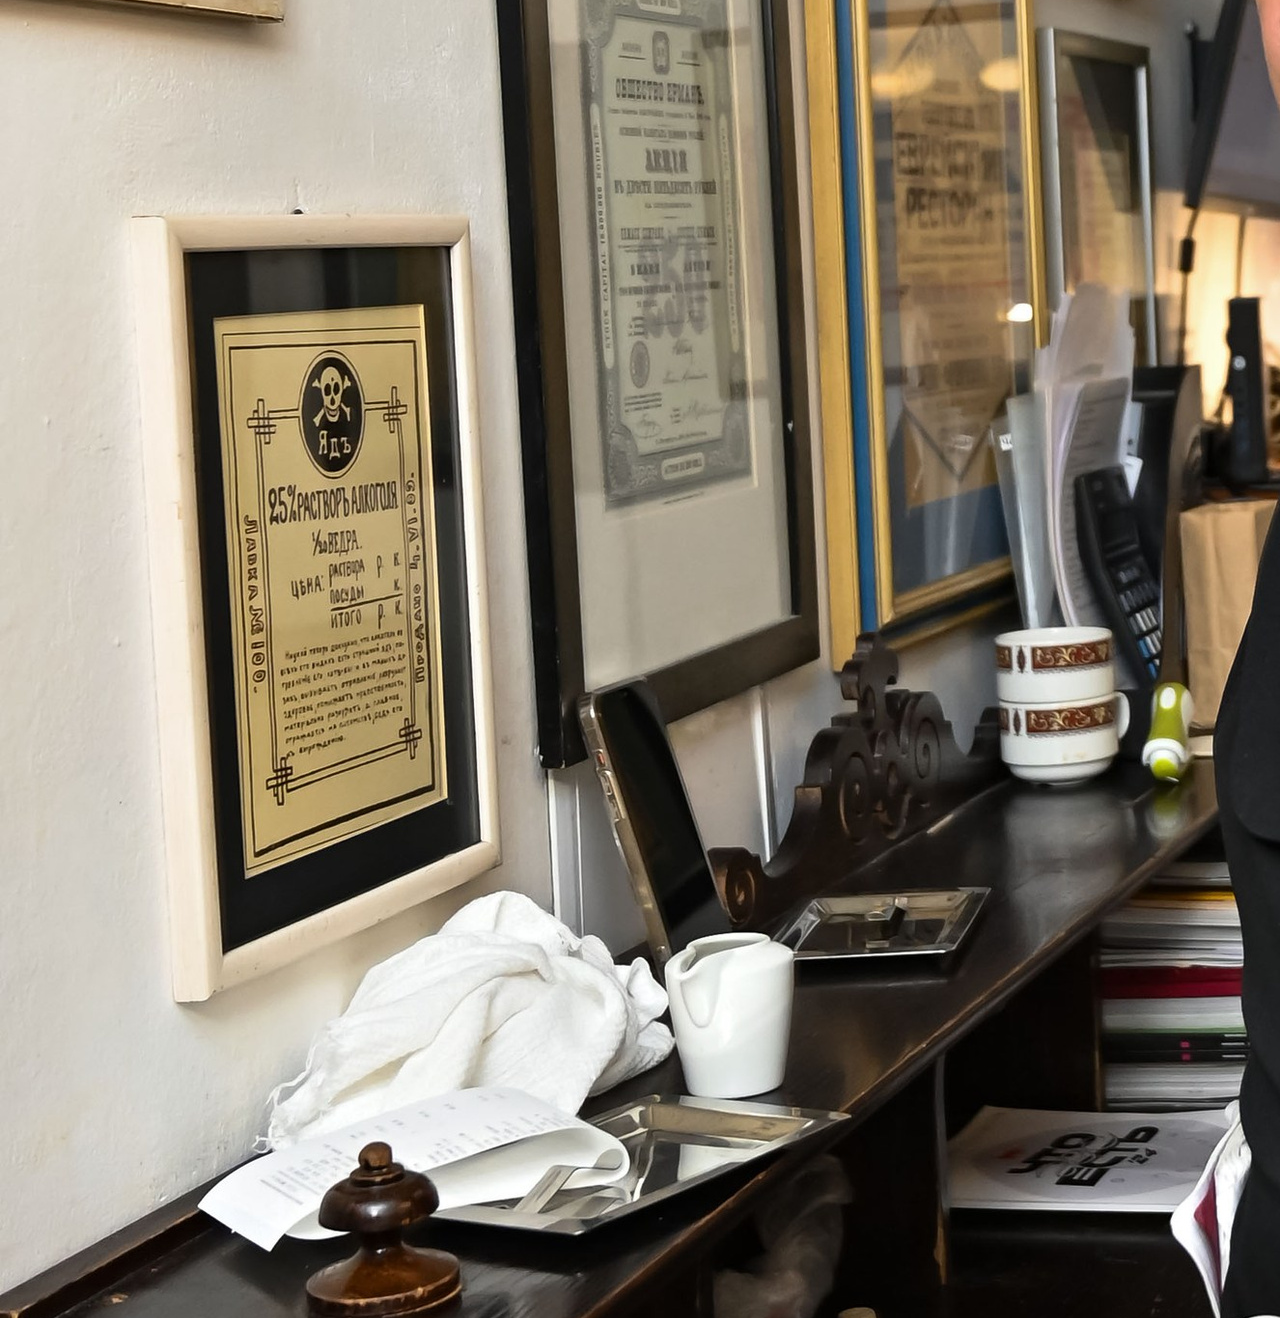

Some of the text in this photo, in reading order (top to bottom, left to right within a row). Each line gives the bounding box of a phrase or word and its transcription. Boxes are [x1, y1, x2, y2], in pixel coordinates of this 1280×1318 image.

[268, 481, 399, 525] 25% РАСТВОРЪ АЛКОГОЛЯ
[328, 529, 362, 557] ВЕДРА.
[330, 585, 364, 604] ПОСУДЫ
[331, 609, 362, 629] ИТОГО
